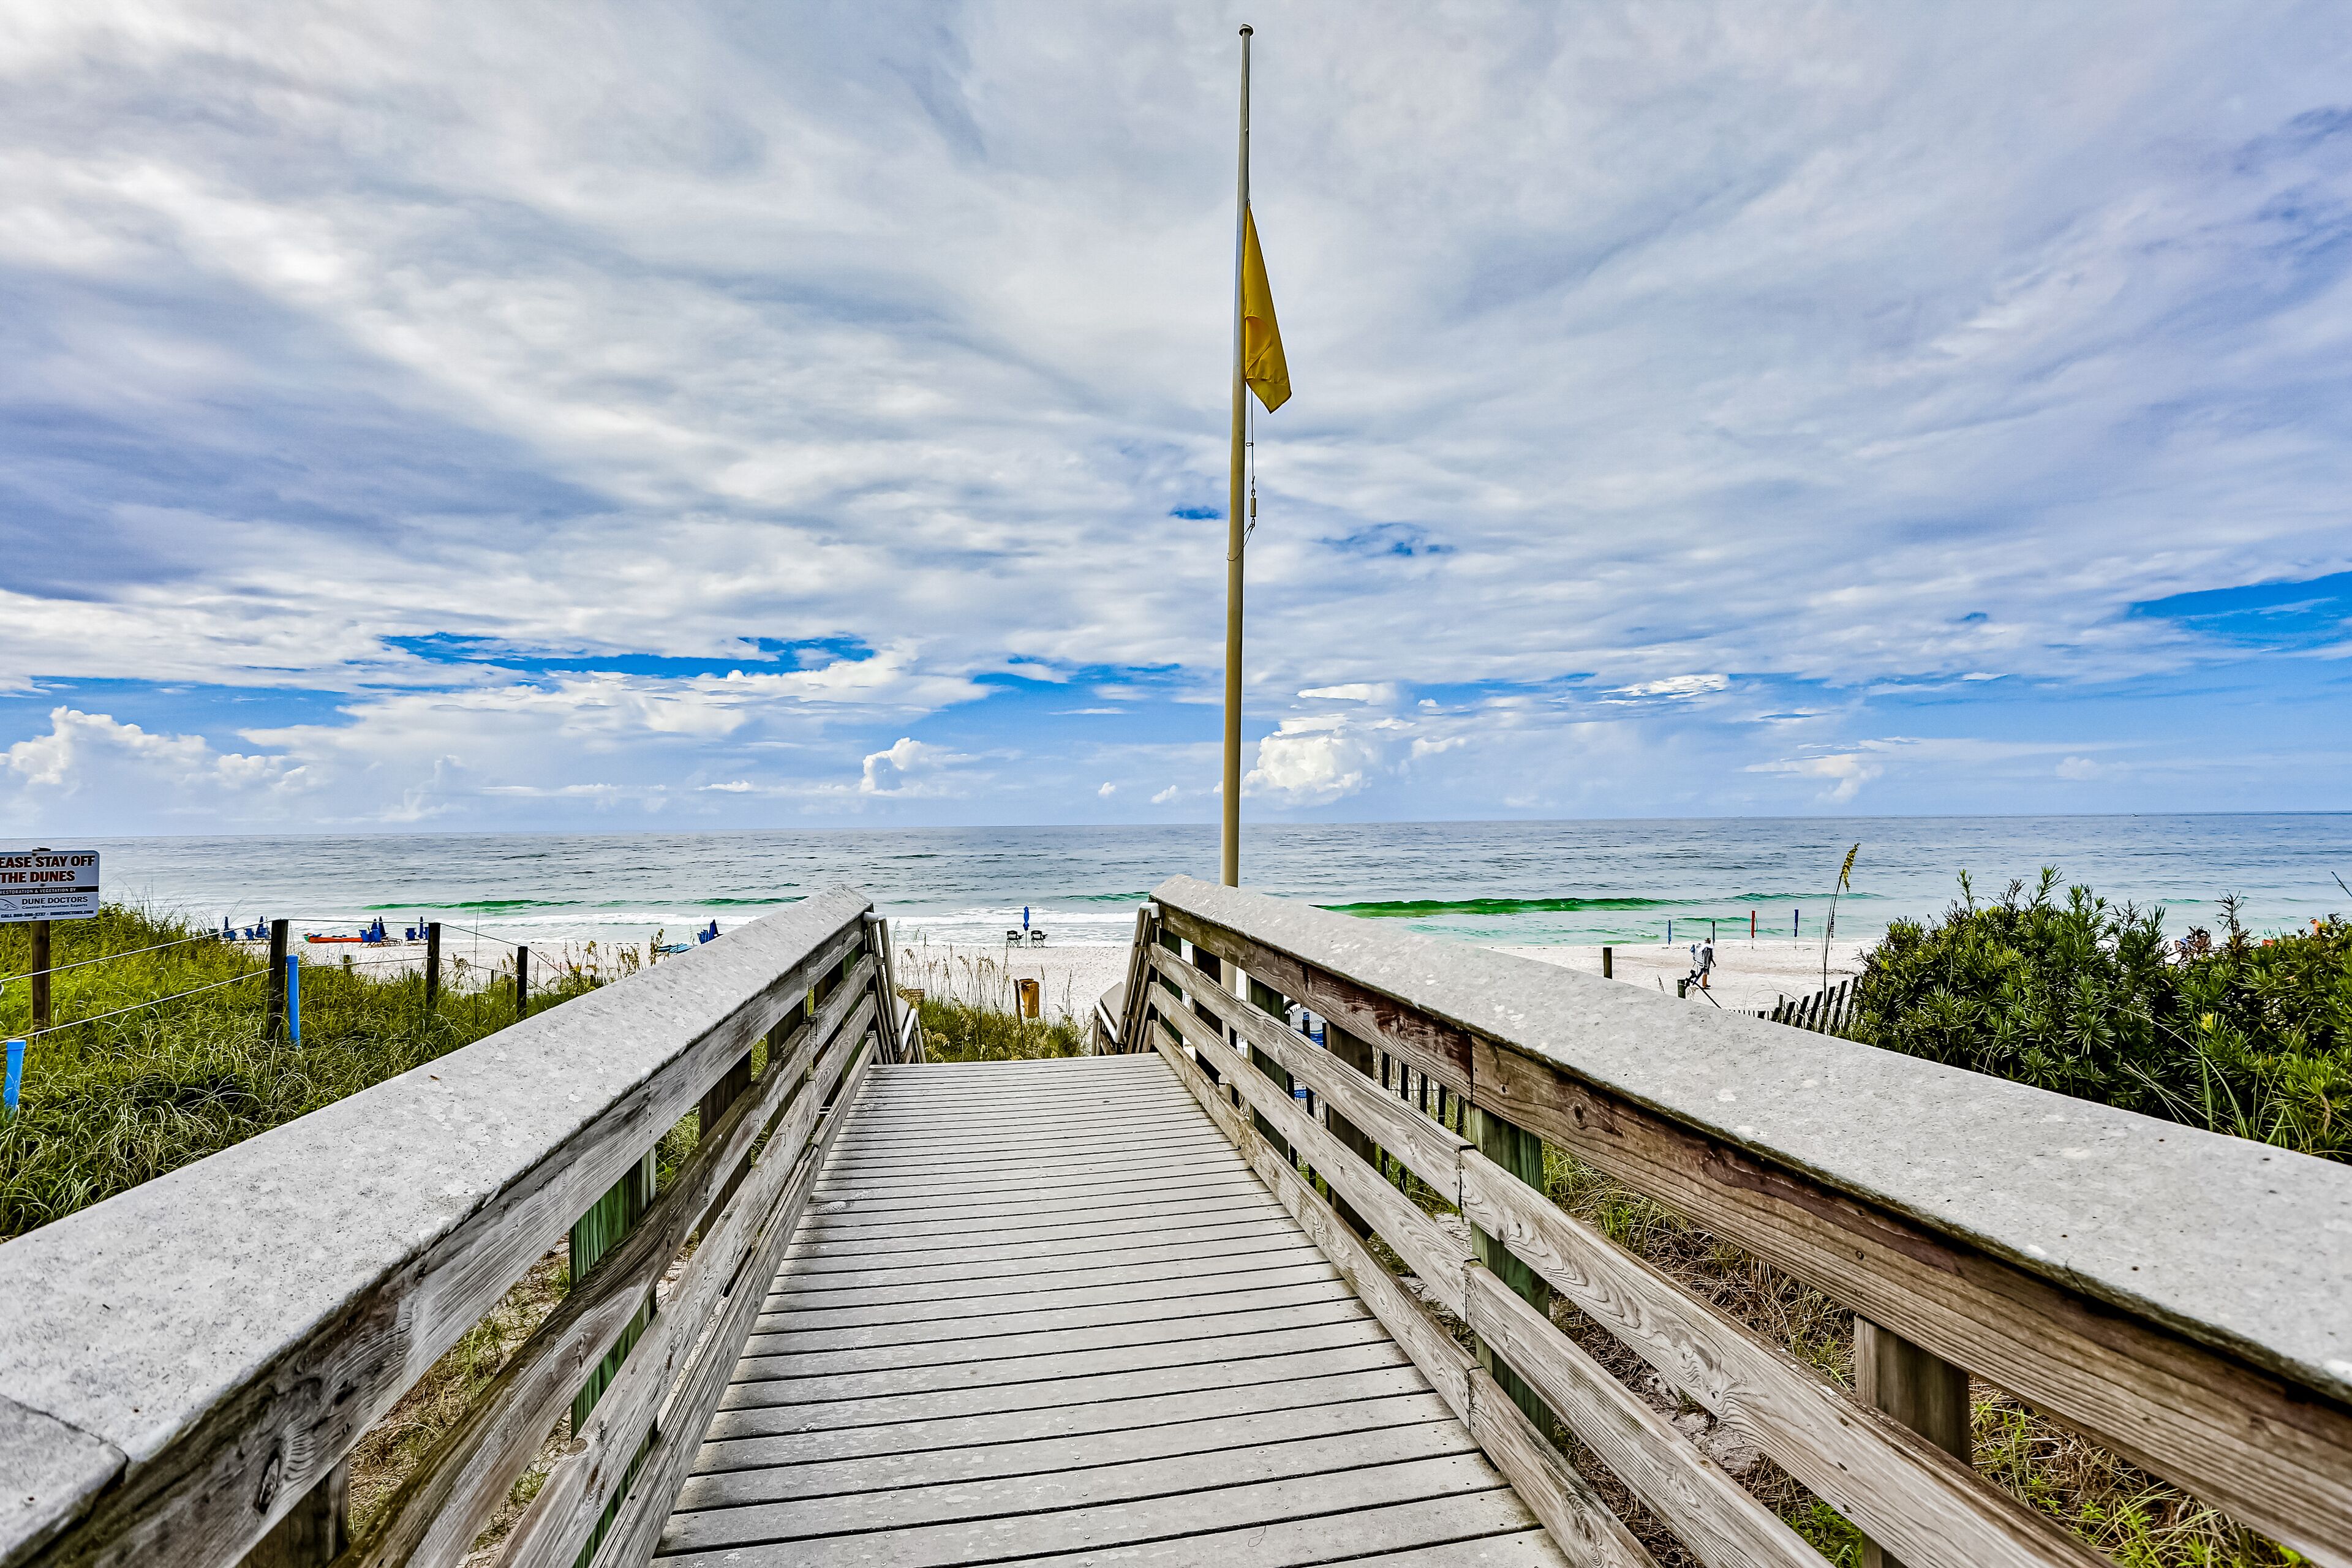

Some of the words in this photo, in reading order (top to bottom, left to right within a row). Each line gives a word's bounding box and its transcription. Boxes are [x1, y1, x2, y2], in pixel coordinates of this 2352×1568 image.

[36, 856, 69, 867] STAY
[70, 855, 96, 867] OFF
[0, 872, 27, 883] THE
[30, 870, 75, 883] DUNES
